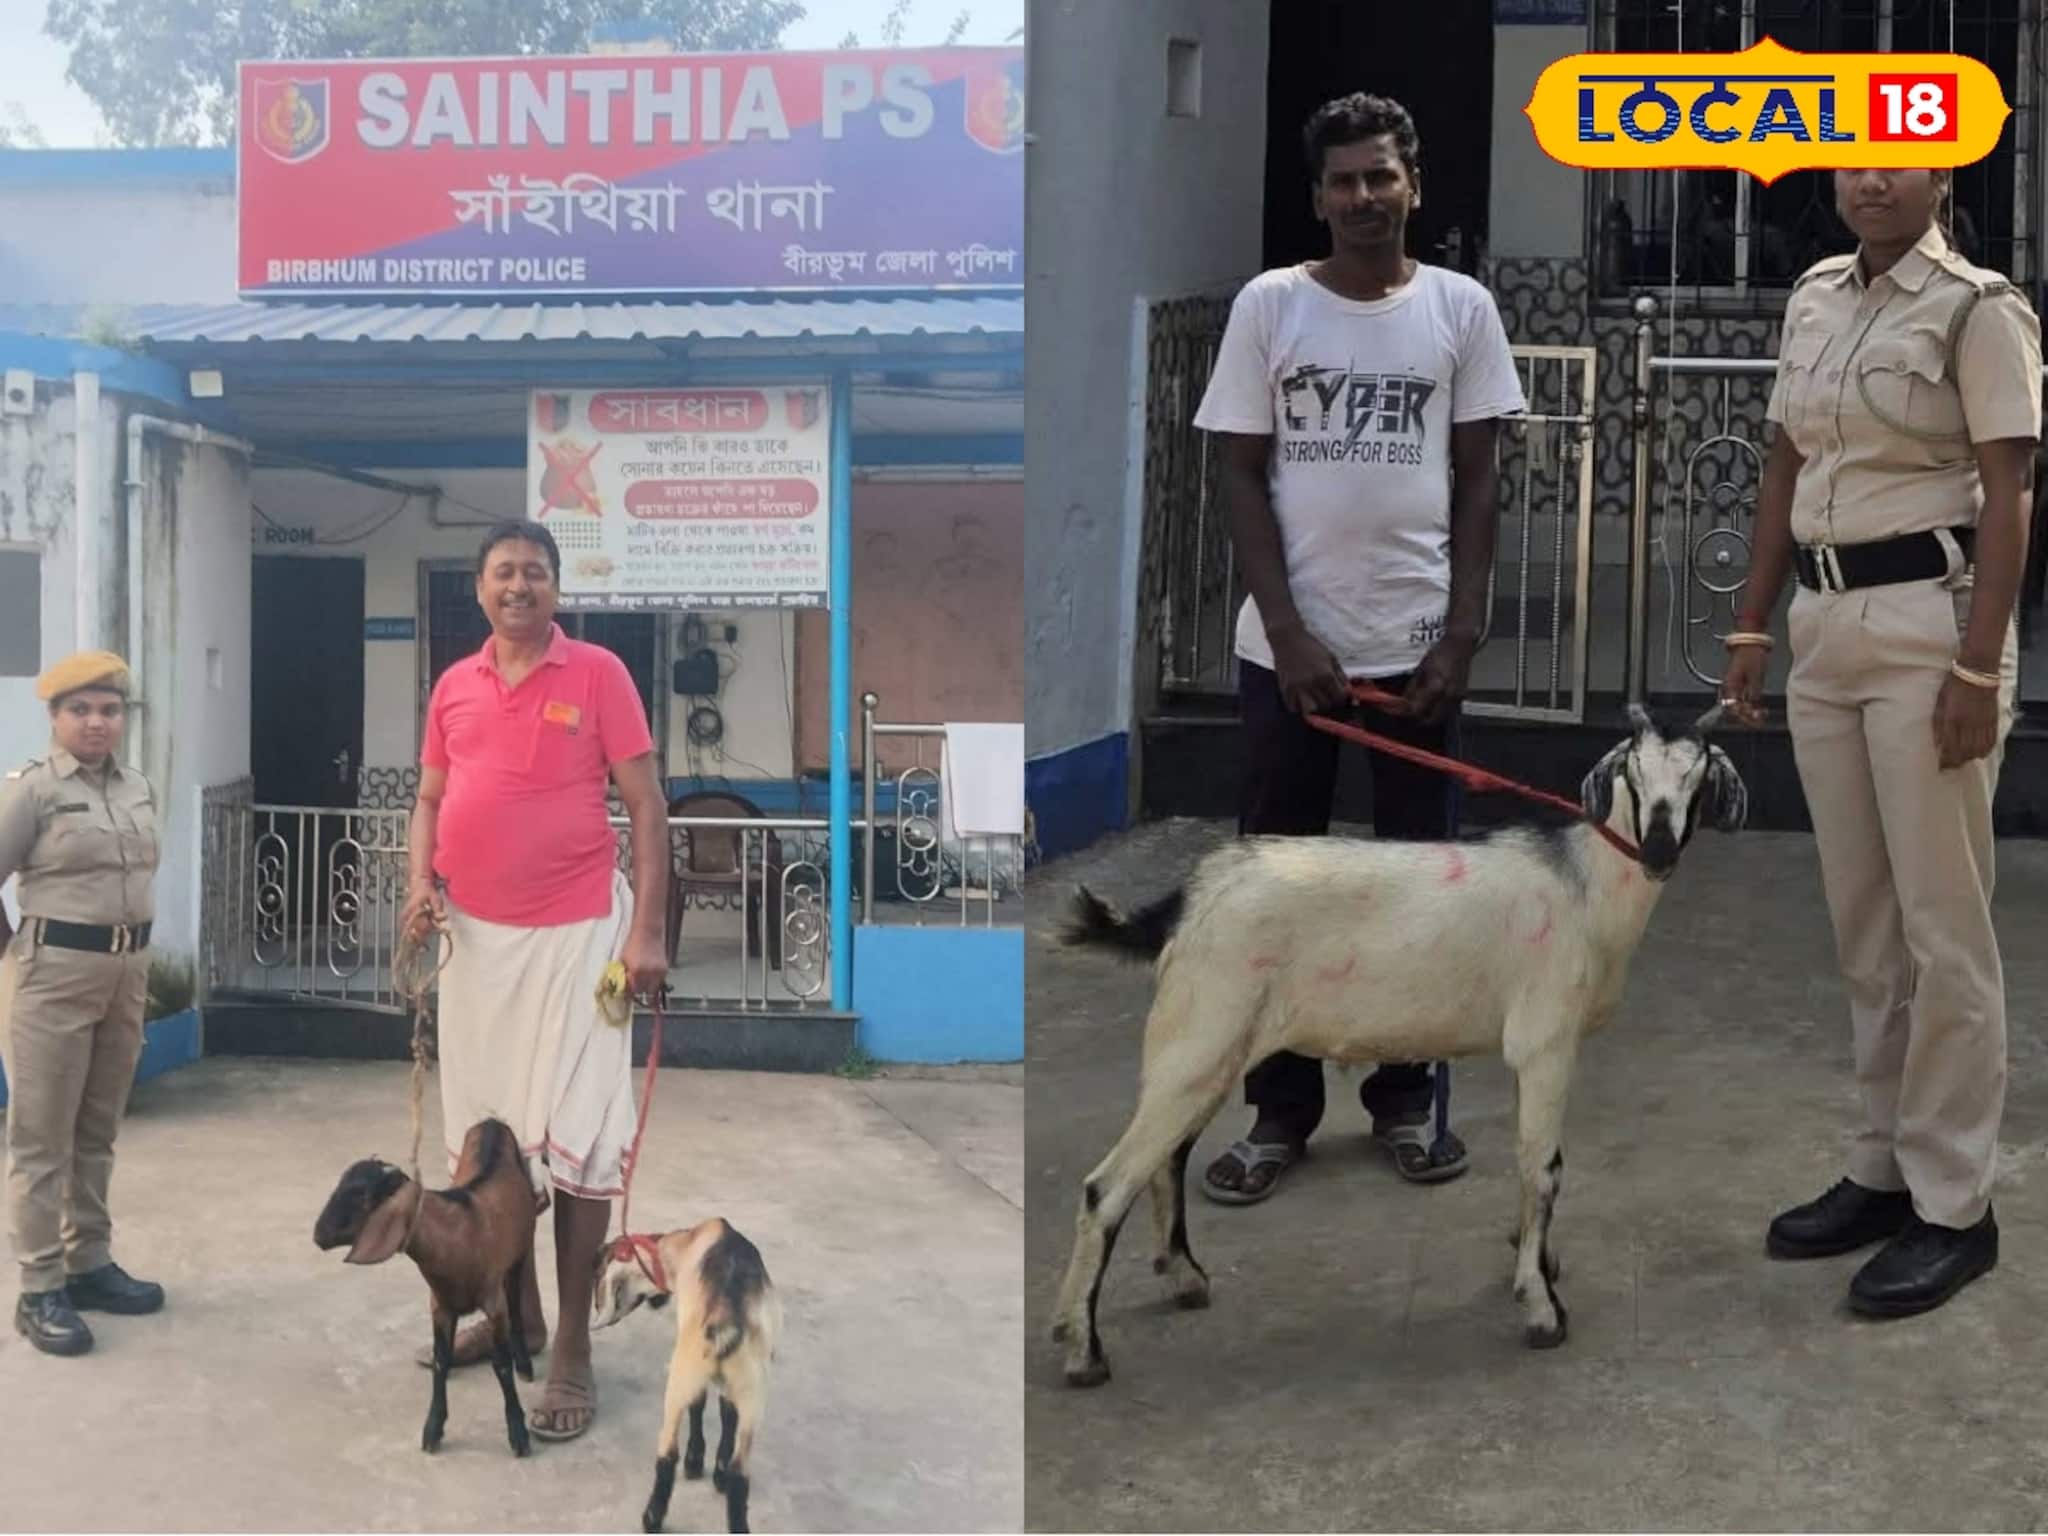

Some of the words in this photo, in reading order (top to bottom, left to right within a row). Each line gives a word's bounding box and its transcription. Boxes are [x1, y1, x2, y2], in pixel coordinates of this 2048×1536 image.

[356, 66, 790, 149] SAINTHIA
[821, 64, 935, 140] PS
[448, 173, 686, 236] সাঁইথিয়া
[706, 180, 834, 231] থানা
[267, 259, 377, 282] BIRBHUM
[383, 258, 494, 282] DISTRICT
[500, 257, 586, 281] POLICE
[875, 249, 938, 273] জেলা
[945, 243, 1016, 279] পুলিশ
[607, 395, 752, 428] সাবধান
[1285, 440, 1342, 462] STRONG
[1352, 441, 1381, 462] FOR
[1387, 442, 1423, 465] BOSS
[265, 527, 315, 544] ROOM
